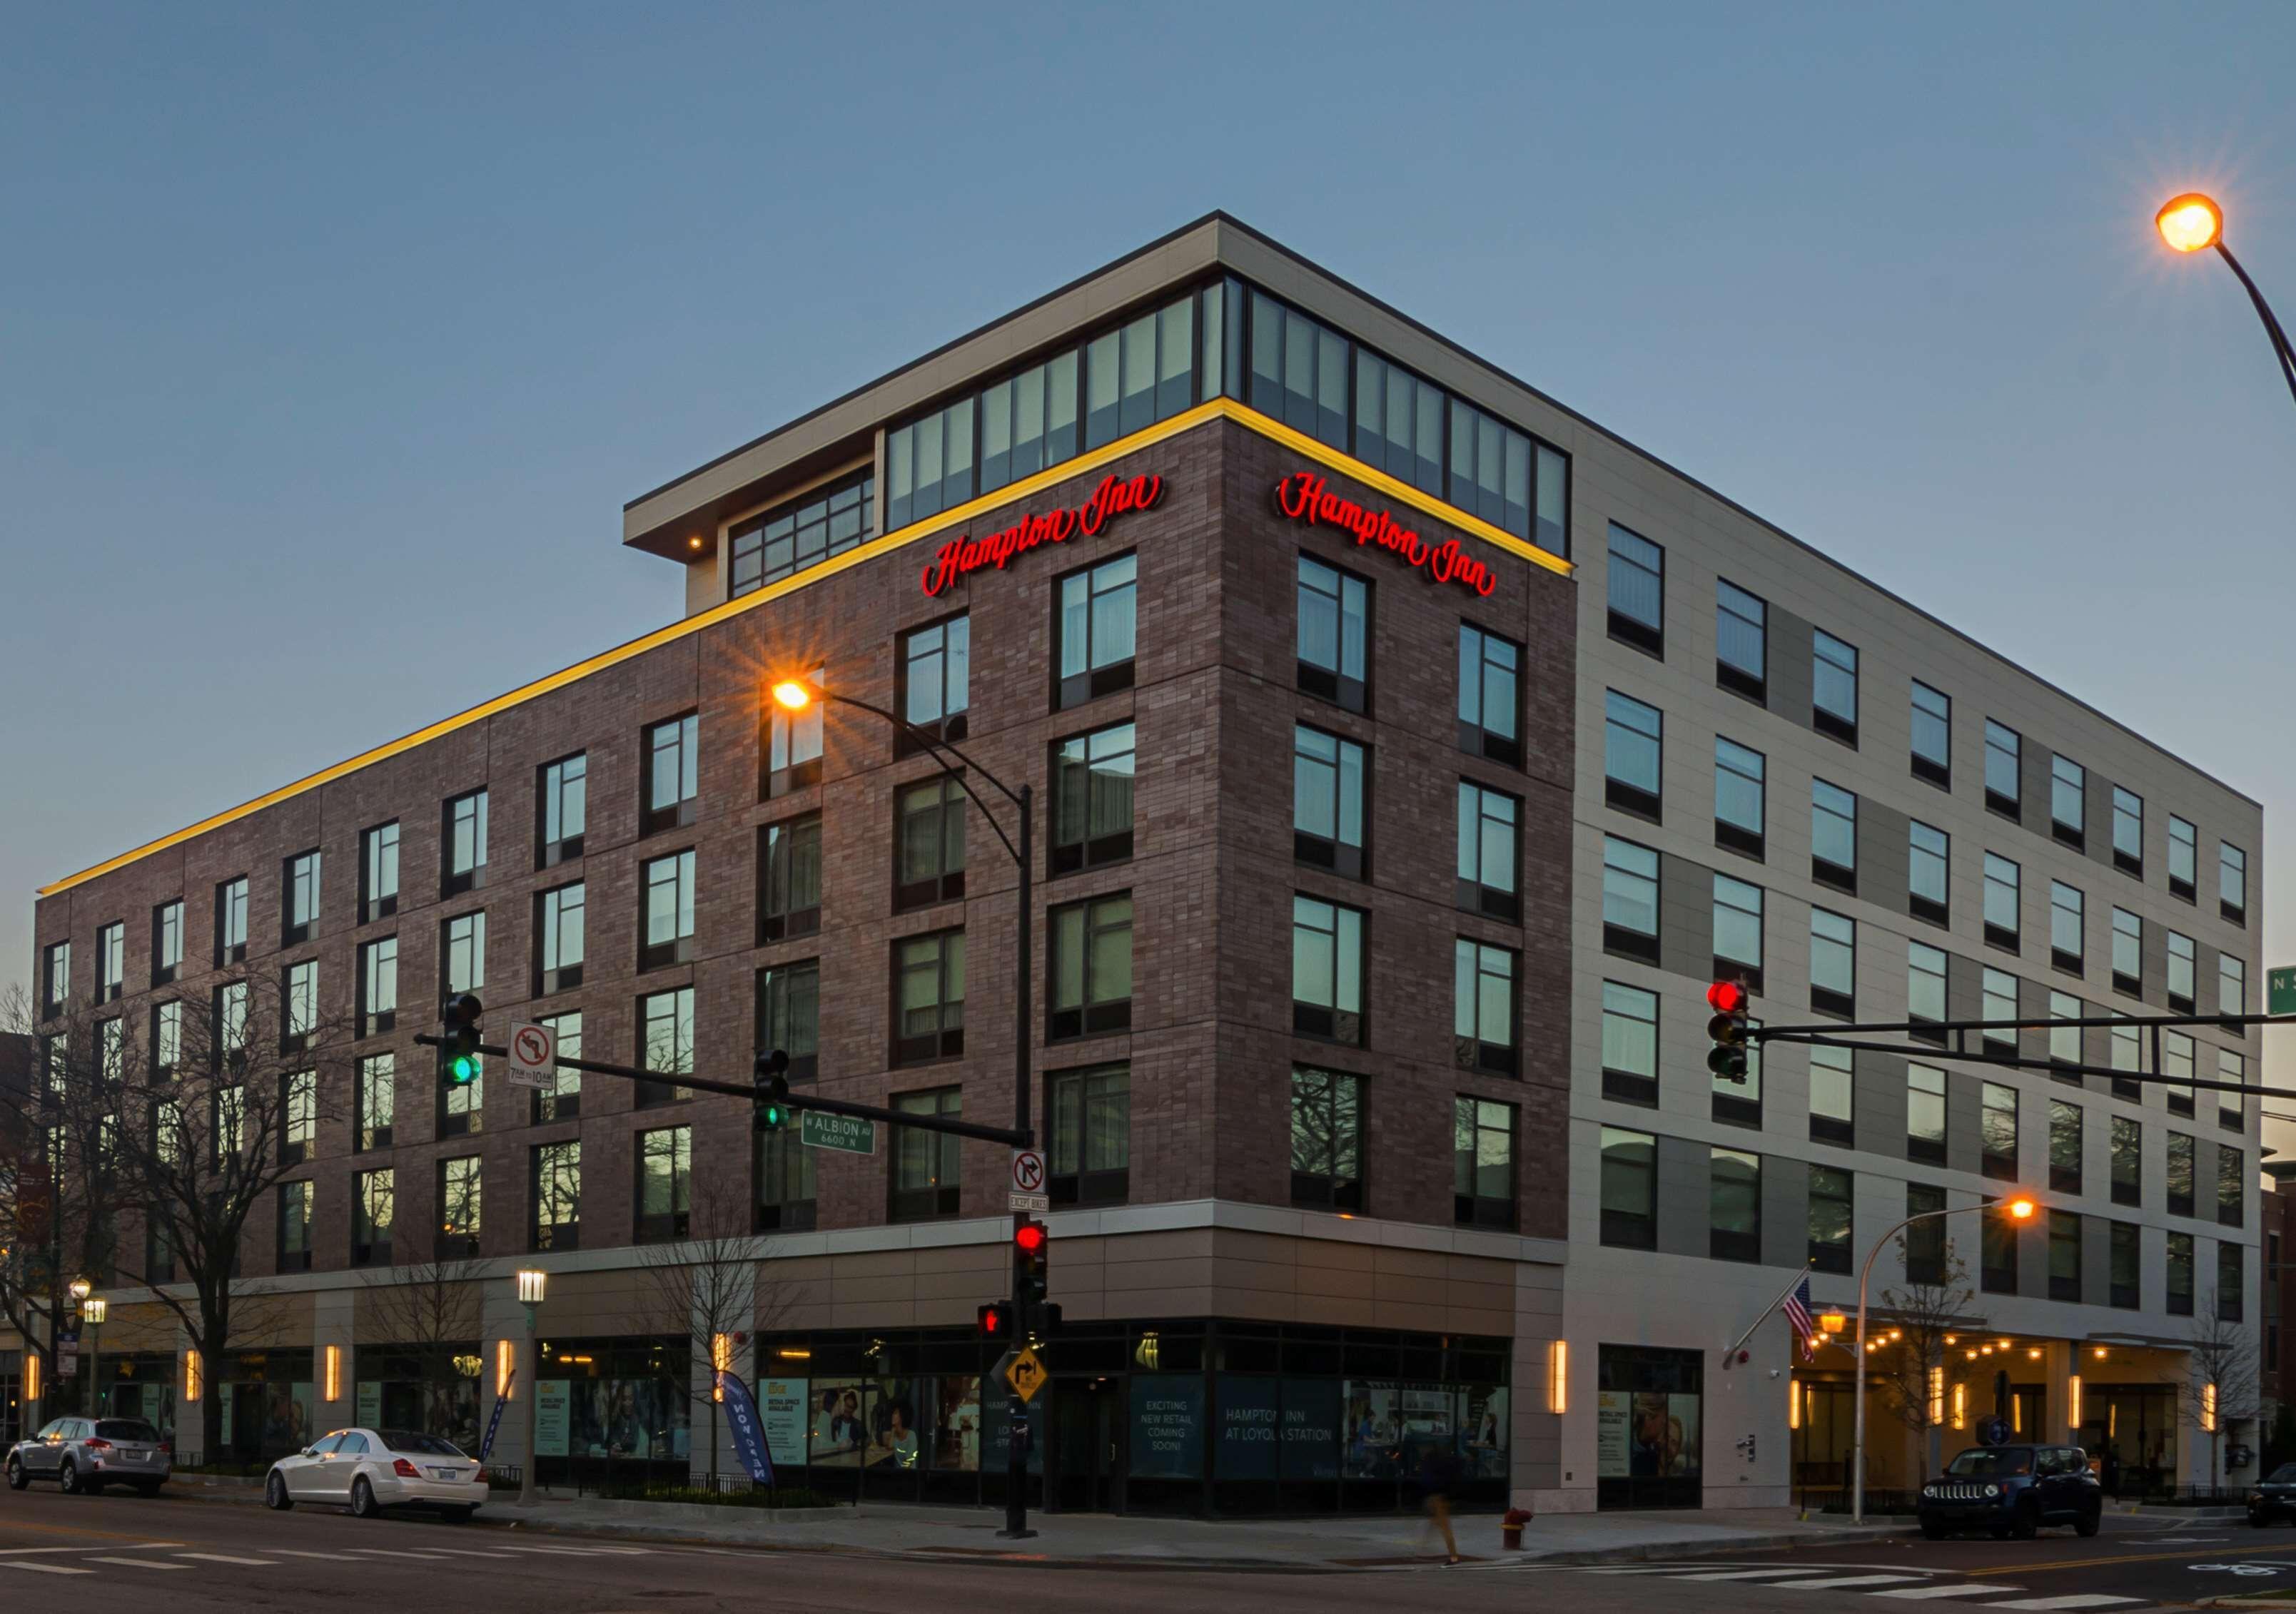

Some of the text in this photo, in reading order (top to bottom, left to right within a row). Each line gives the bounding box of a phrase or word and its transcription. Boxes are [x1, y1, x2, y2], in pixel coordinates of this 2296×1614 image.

[923, 474, 1160, 597] Hampton Inn
[1279, 472, 1496, 597] Hampton Inn
[2274, 977, 2285, 990] N
[815, 1117, 859, 1136] ALBION
[821, 1134, 856, 1147] 6600 N
[1146, 1400, 1188, 1411] EXCITING
[1141, 1414, 1192, 1424] NEW RETAIL
[1285, 1410, 1305, 1422] INN
[1148, 1428, 1185, 1438] COMING
[1225, 1428, 1240, 1440] AT
[1287, 1428, 1332, 1441] STATION
